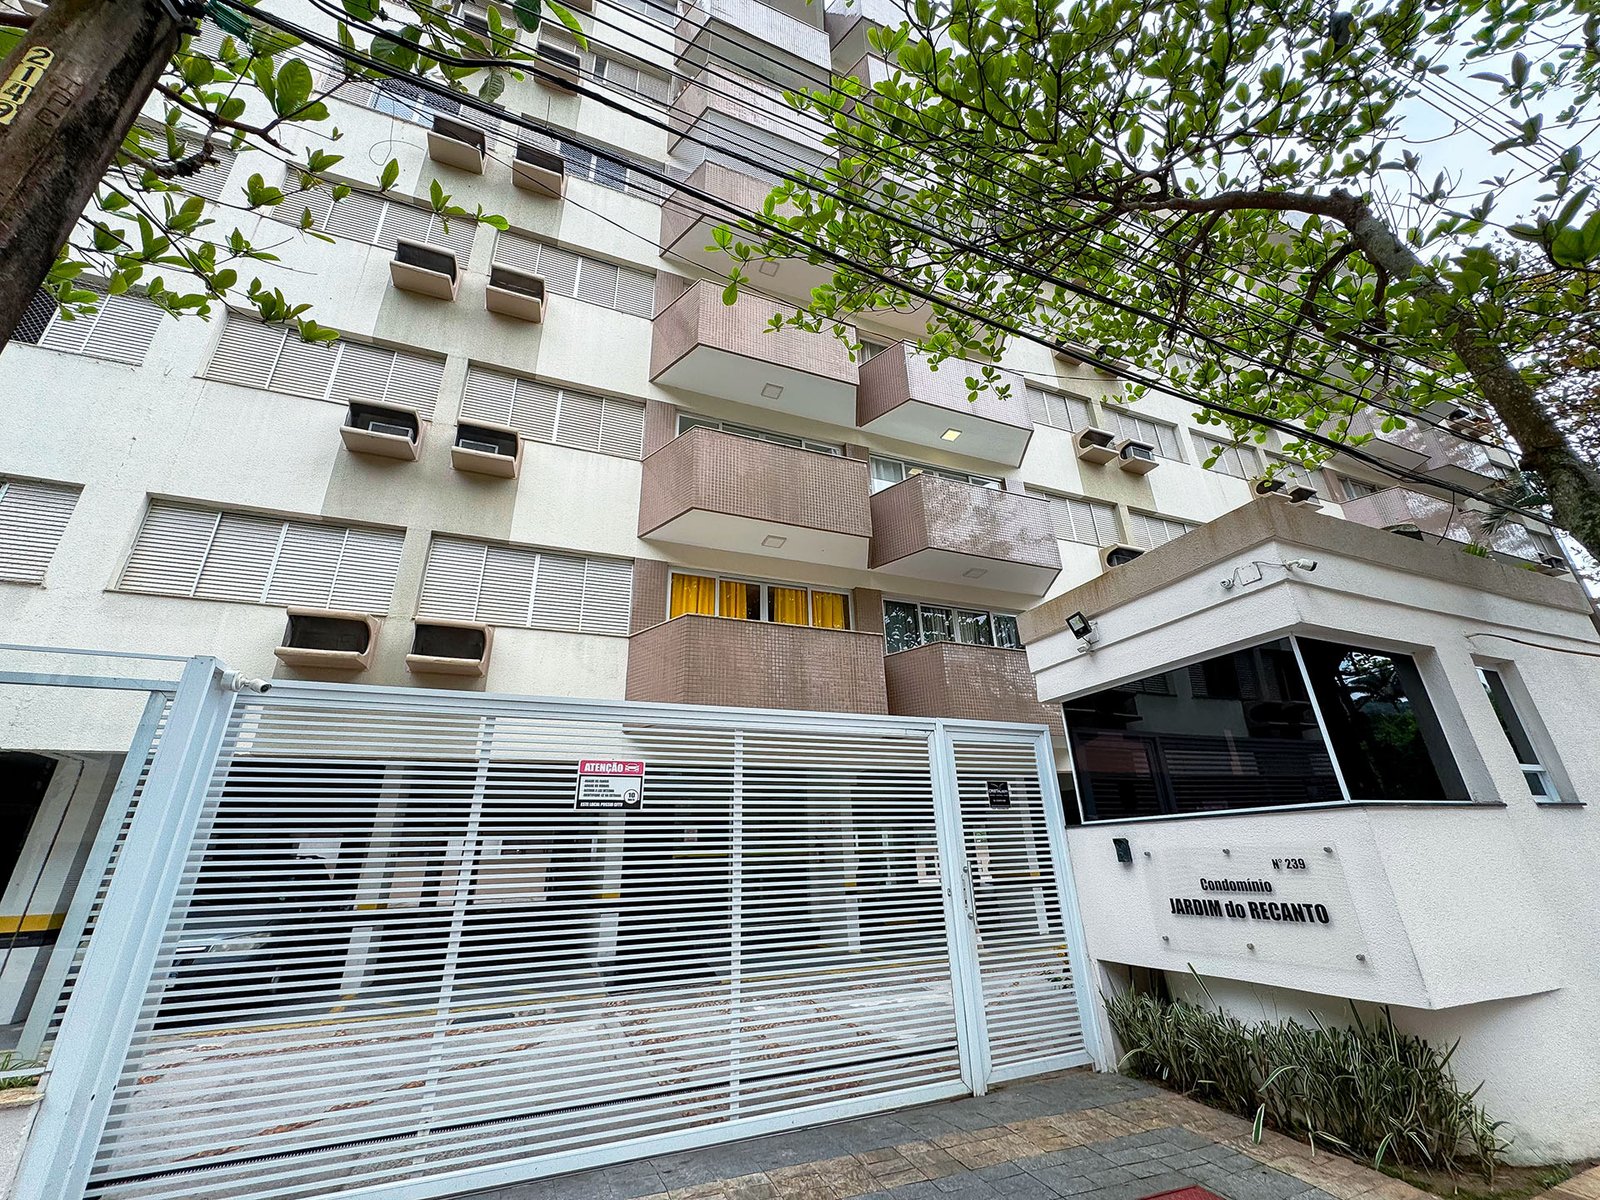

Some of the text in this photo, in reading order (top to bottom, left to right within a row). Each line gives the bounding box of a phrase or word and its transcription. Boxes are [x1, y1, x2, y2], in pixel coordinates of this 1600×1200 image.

[584, 762, 624, 774] ATENÇÃO
[1284, 858, 1306, 870] 239
[1200, 878, 1273, 893] Condomínio
[1169, 898, 1330, 924] JARDIM do RECANTO
